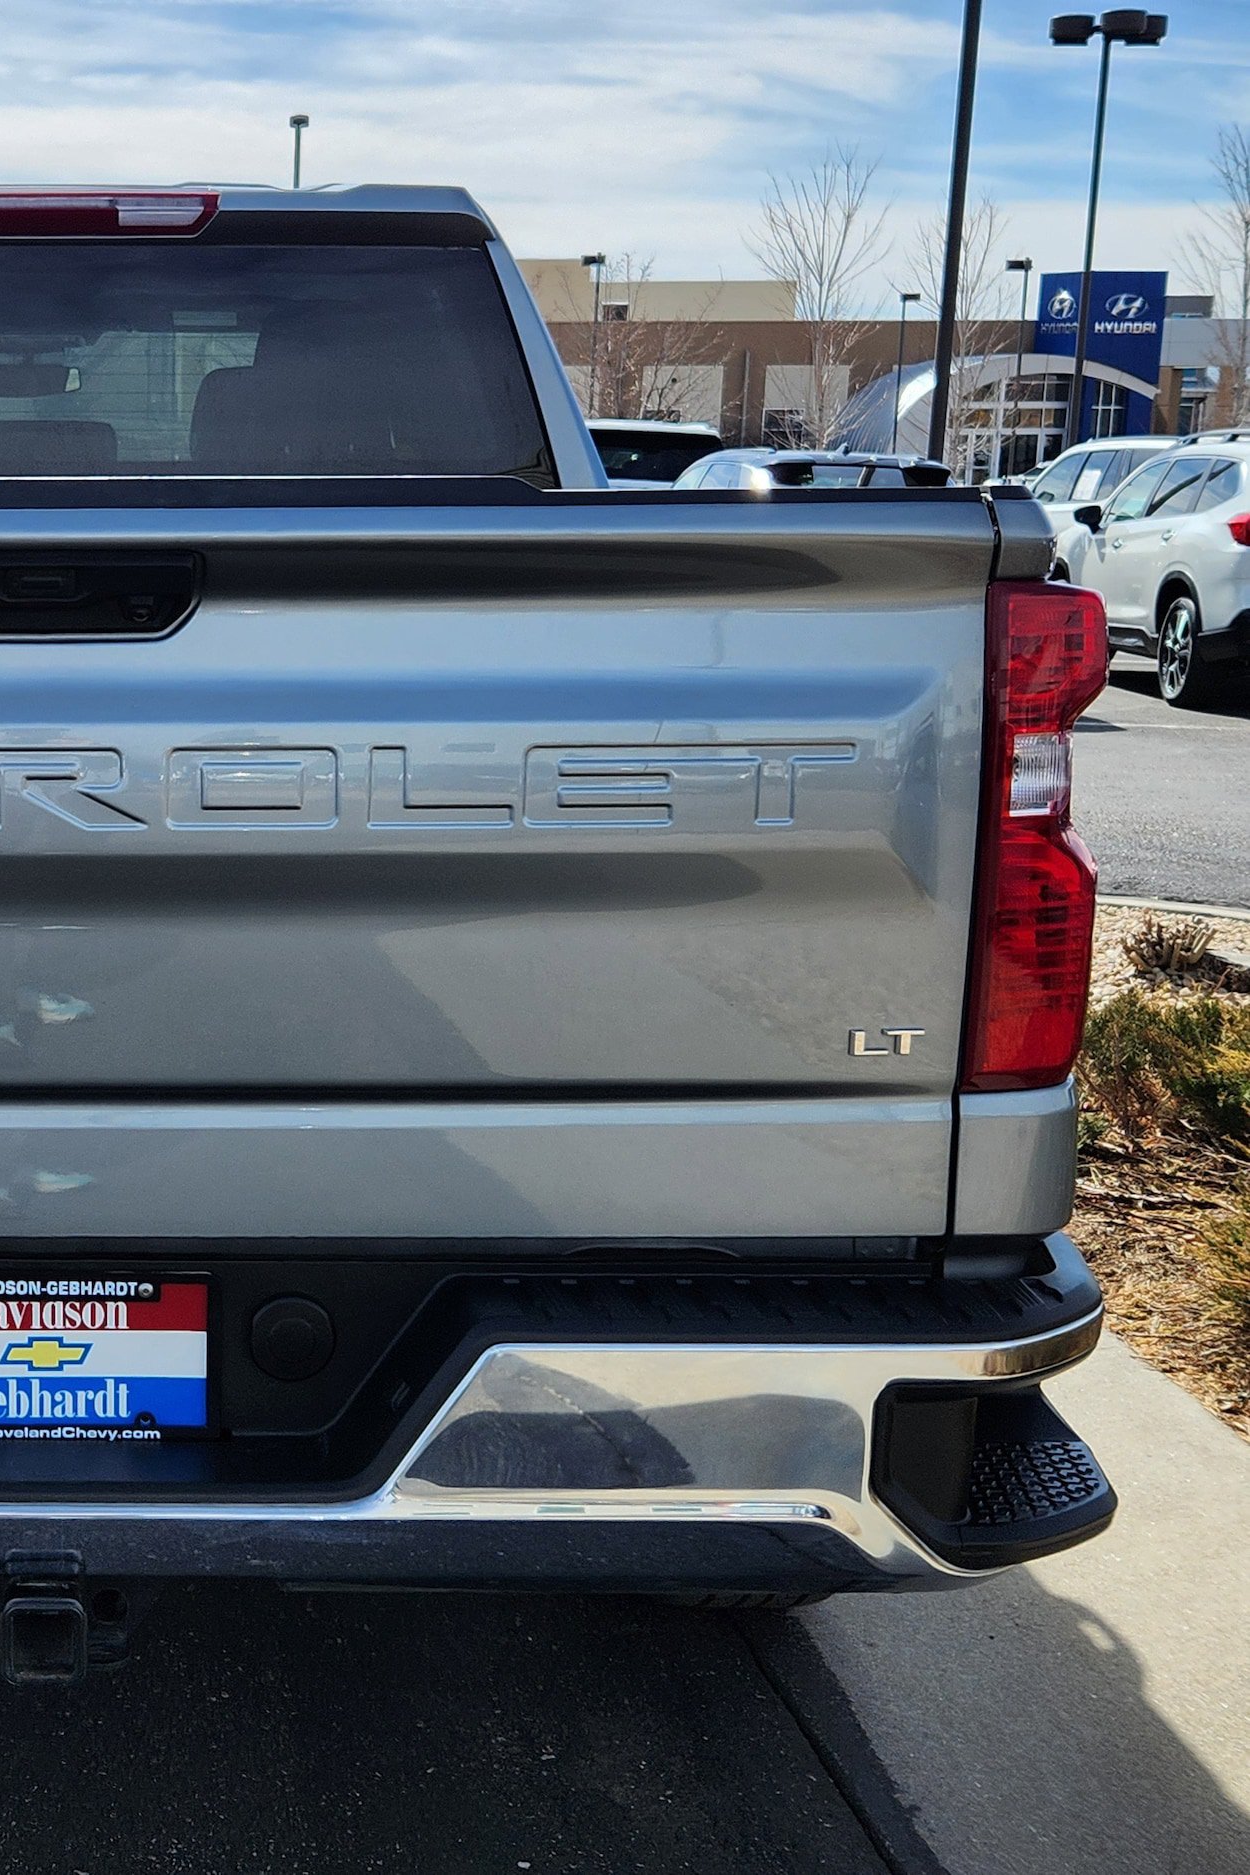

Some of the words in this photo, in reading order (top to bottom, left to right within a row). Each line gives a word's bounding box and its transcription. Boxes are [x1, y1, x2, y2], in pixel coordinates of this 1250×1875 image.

[1040, 322, 1079, 334] HYUNDA
[1094, 320, 1157, 334] HYUNDAI
[848, 1028, 926, 1056] LT
